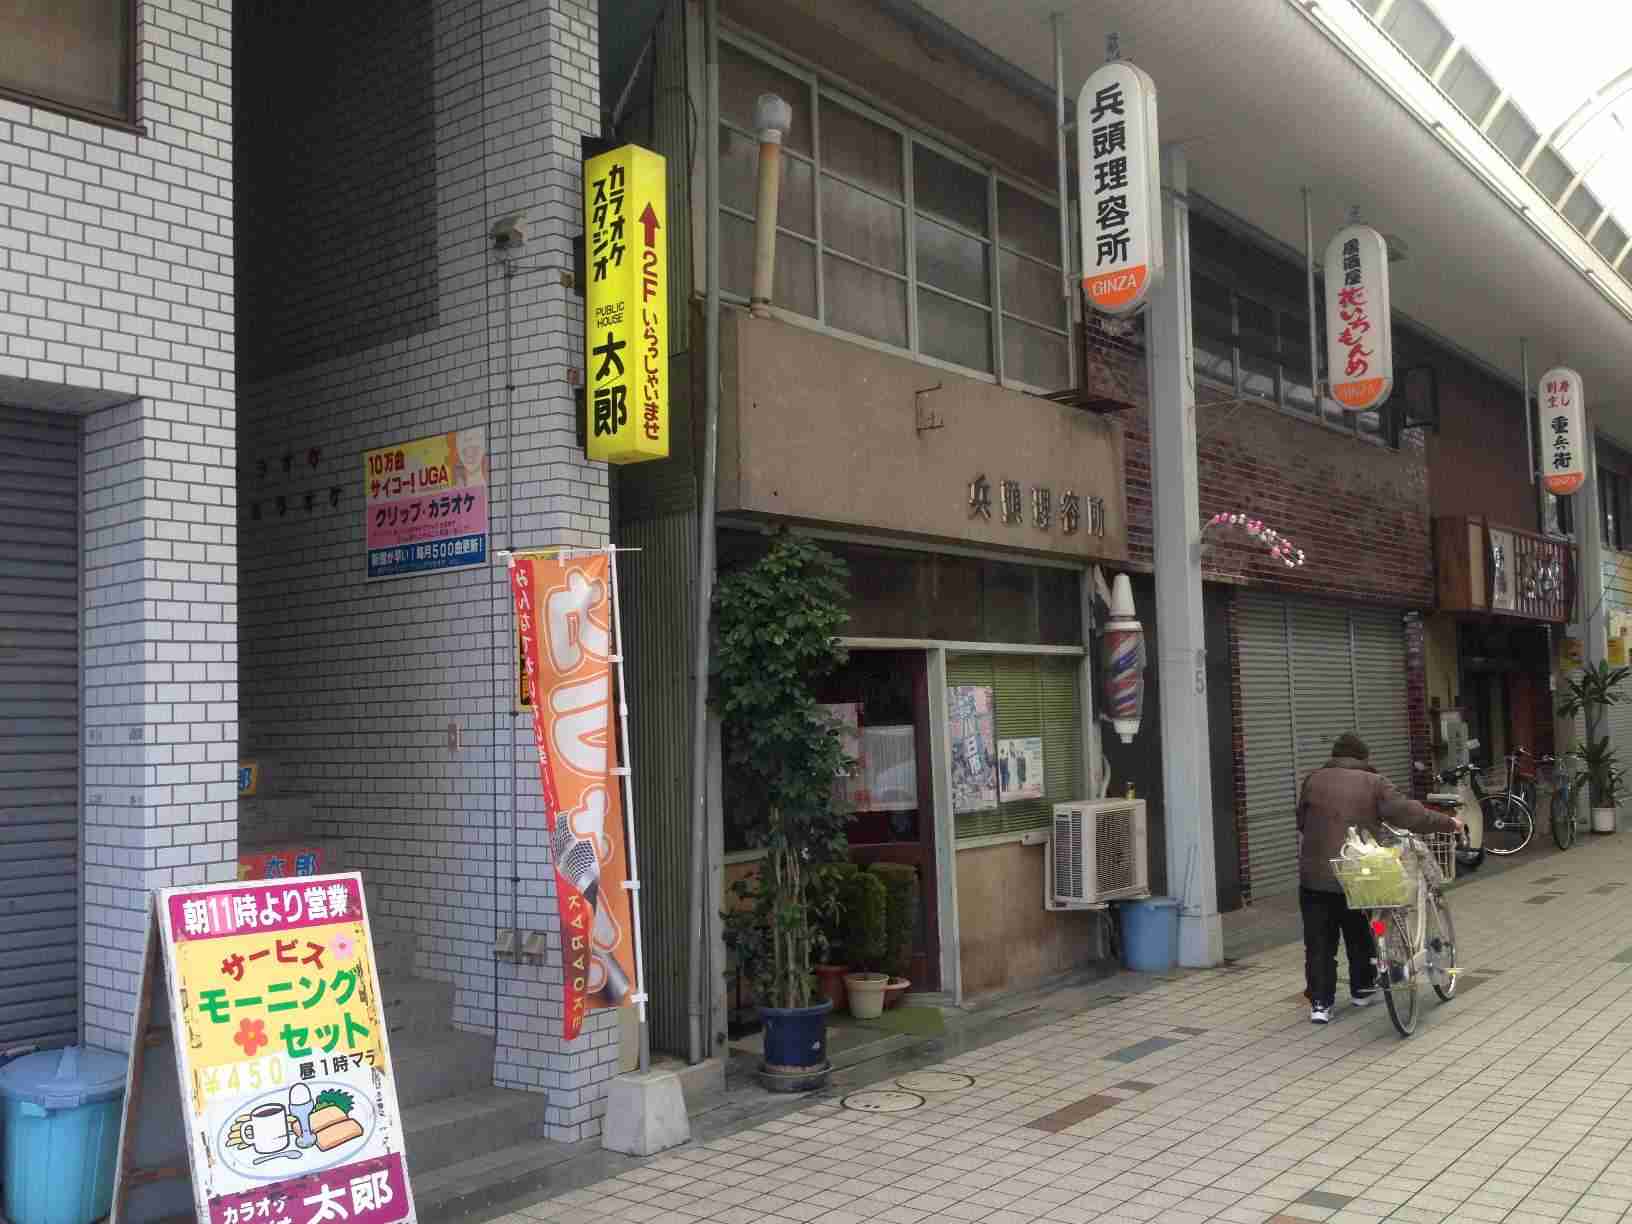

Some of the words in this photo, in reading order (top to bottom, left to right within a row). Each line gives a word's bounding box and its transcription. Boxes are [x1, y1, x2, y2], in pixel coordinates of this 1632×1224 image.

[1090, 82, 1131, 267] 兵頭理容所
[592, 178, 608, 282] スタジオ
[608, 163, 625, 267] カラオケ
[595, 300, 625, 317] PUBLIC
[1091, 273, 1138, 298] GINZA
[597, 314, 624, 330] HOUSE
[592, 331, 628, 438] 太郎
[641, 308, 660, 441] いらっしゃいませ
[418, 465, 449, 487] UGA
[182, 884, 349, 935] 朝11時より営業
[221, 938, 327, 982] サービス
[198, 964, 363, 1025] モーニング
[279, 1011, 370, 1059] セット
[303, 1168, 394, 1224] 太郎
